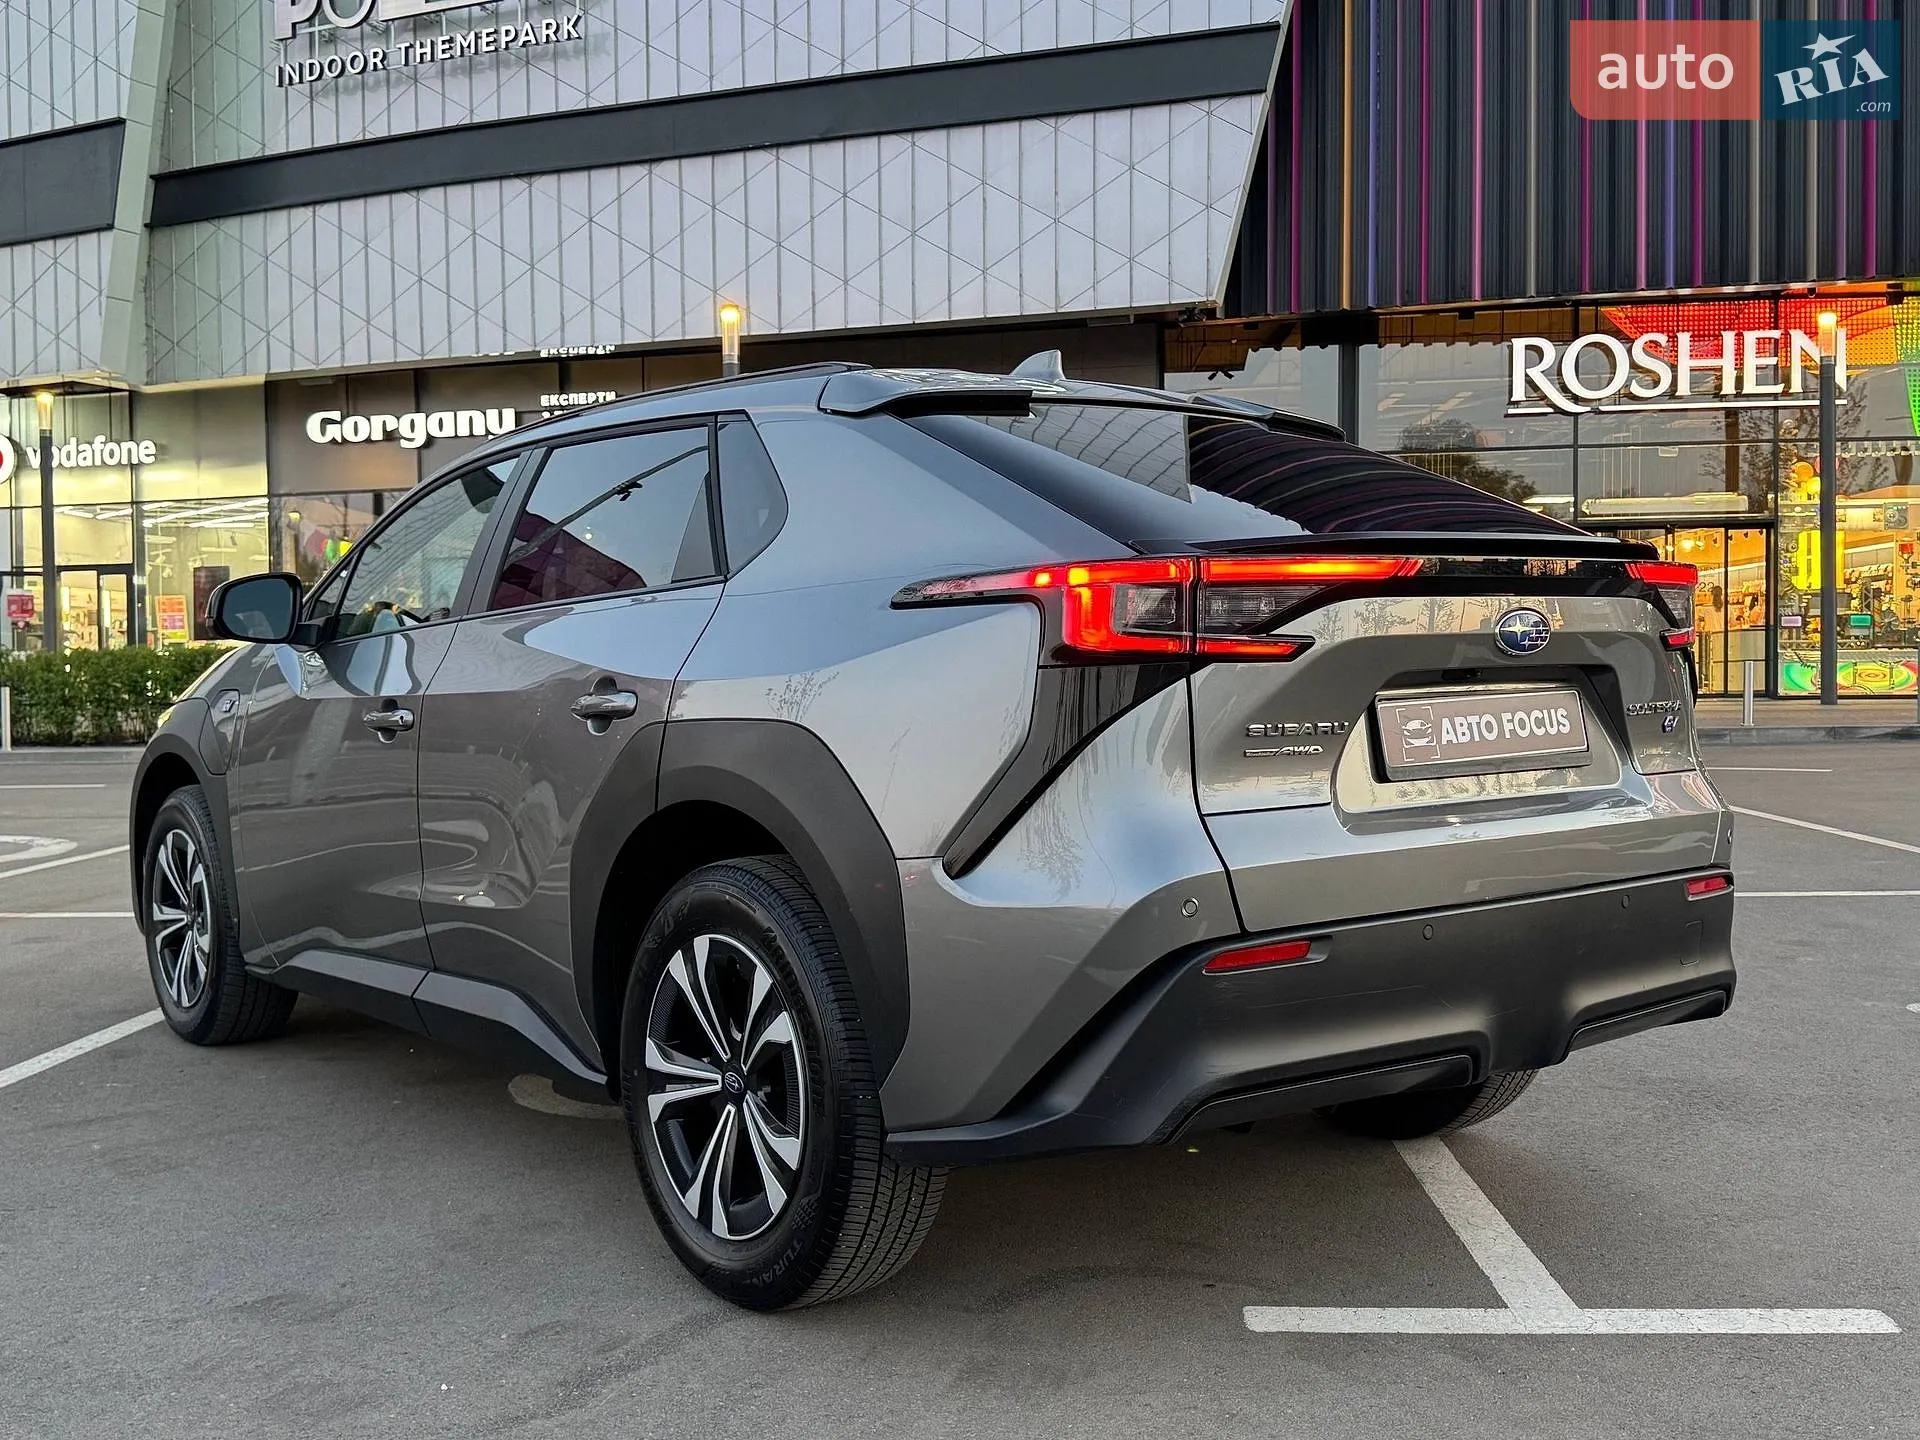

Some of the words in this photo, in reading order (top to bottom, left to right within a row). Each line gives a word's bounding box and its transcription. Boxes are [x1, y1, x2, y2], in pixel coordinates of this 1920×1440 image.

[275, 48, 386, 87] INDOOR
[397, 14, 582, 66] THEMEPARK
[1510, 328, 1847, 413] ROSHEN
[306, 407, 516, 449] Gorgany
[1247, 721, 1349, 737] SUBARU
[1441, 714, 1499, 744] АВТО
[1501, 708, 1570, 739] FOCUS
[1276, 745, 1323, 756] AWD
